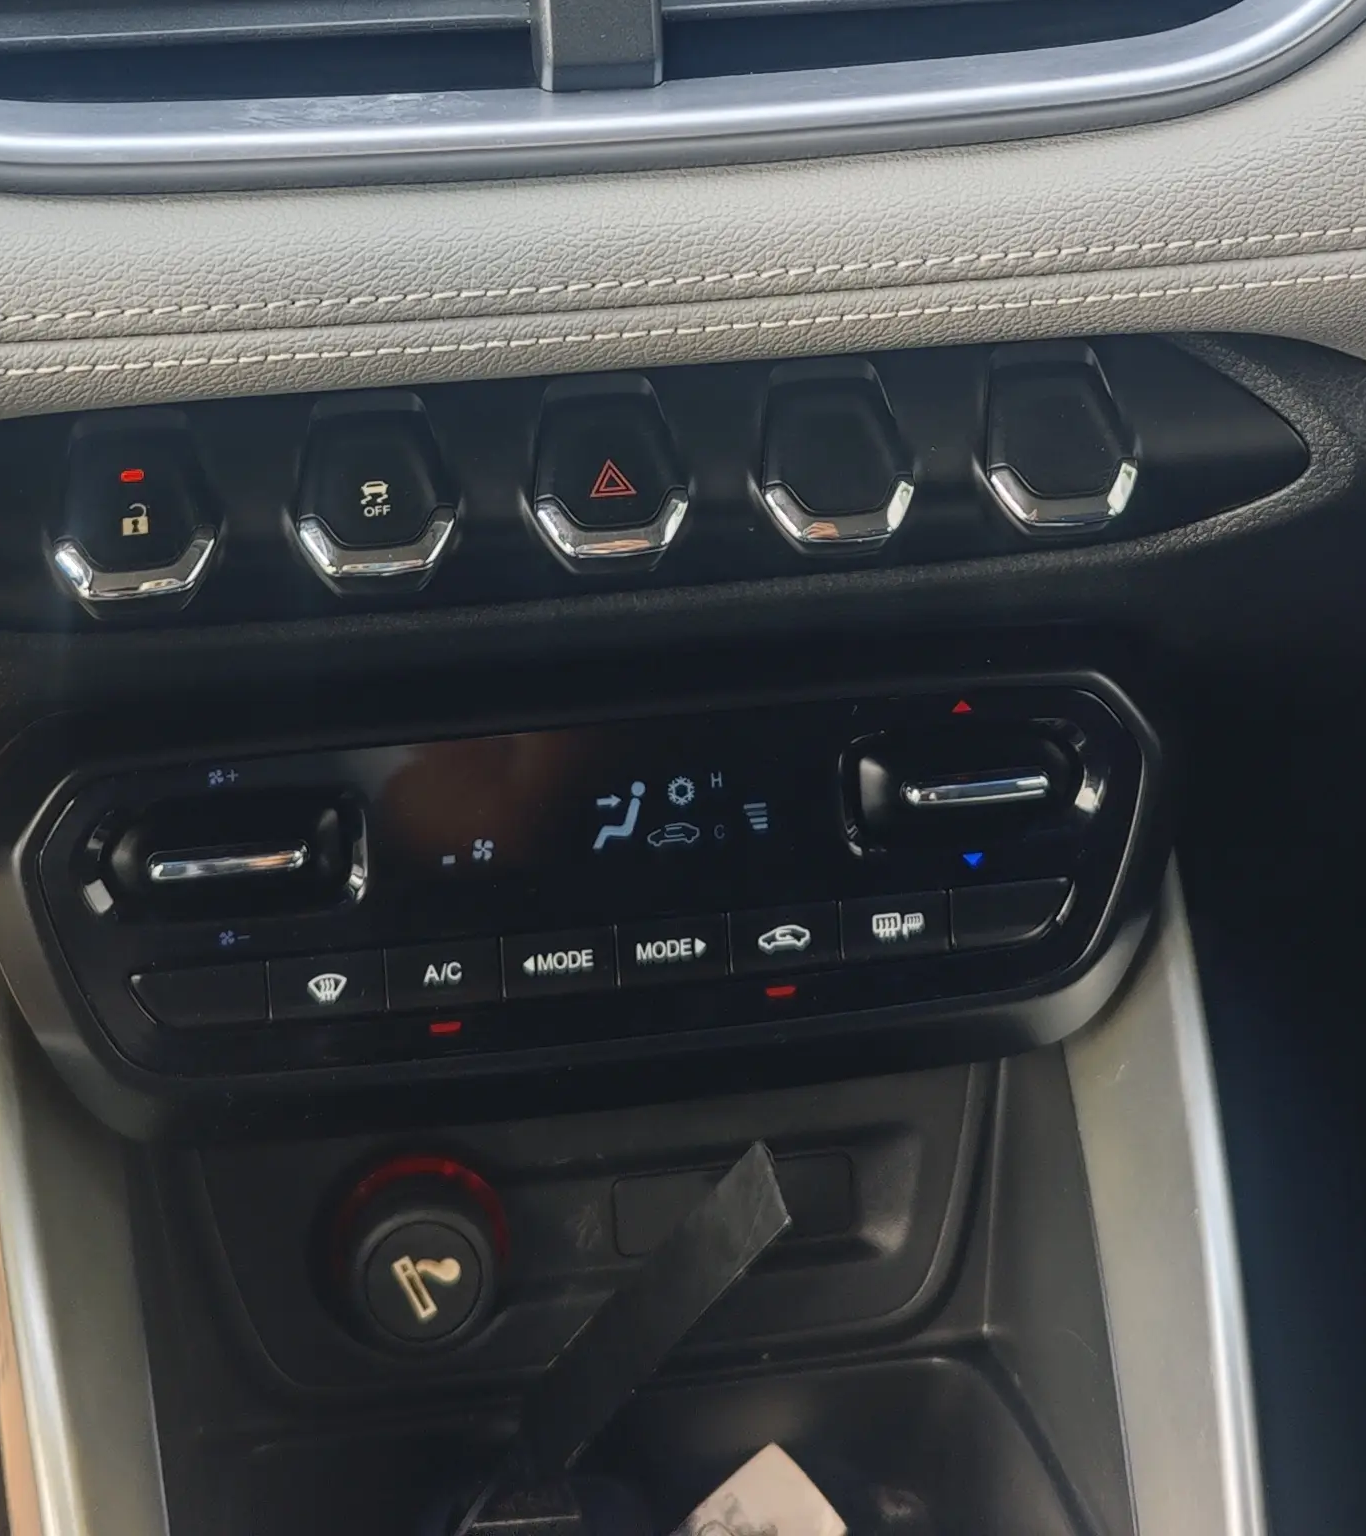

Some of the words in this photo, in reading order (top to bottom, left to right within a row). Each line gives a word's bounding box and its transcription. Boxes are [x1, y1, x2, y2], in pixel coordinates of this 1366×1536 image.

[363, 504, 392, 518] OFF
[537, 948, 595, 972] MODE
[636, 937, 693, 961] MODE
[424, 960, 463, 985] A/C
